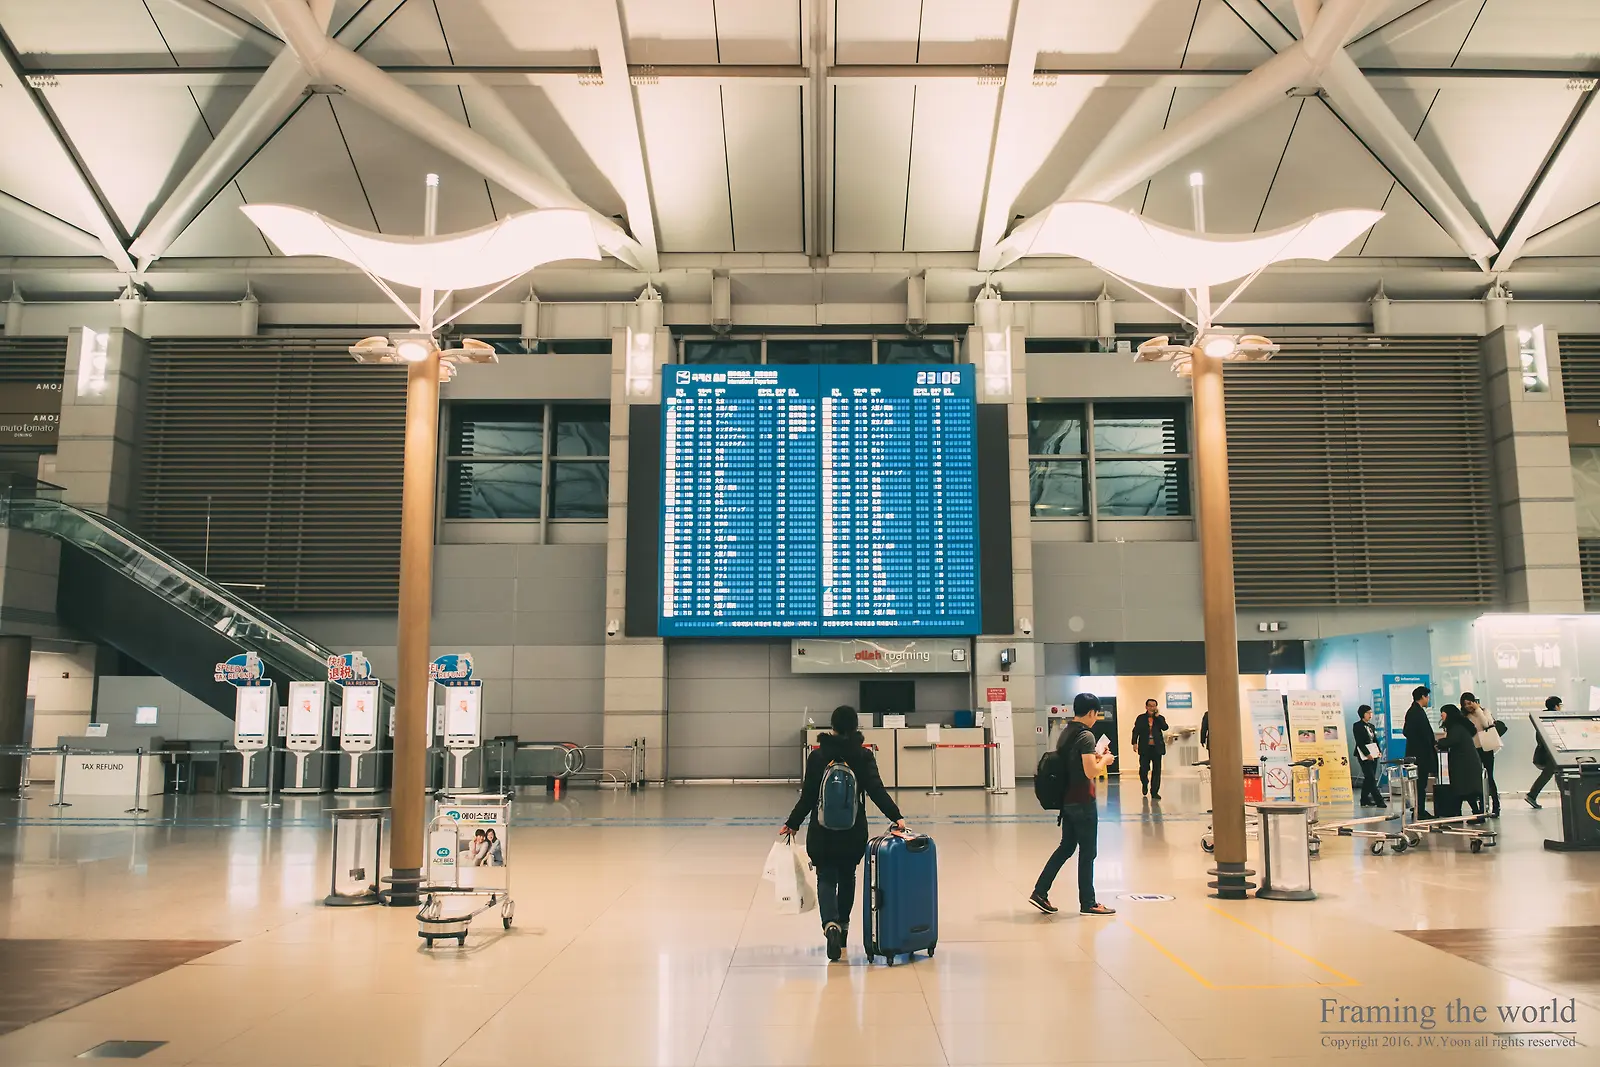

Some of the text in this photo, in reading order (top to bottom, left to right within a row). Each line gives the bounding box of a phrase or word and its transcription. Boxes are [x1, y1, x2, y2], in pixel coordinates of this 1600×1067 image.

[23, 424, 54, 432] tomato
[855, 650, 930, 662] olleh roaming
[461, 812, 497, 820] 에이스침대
